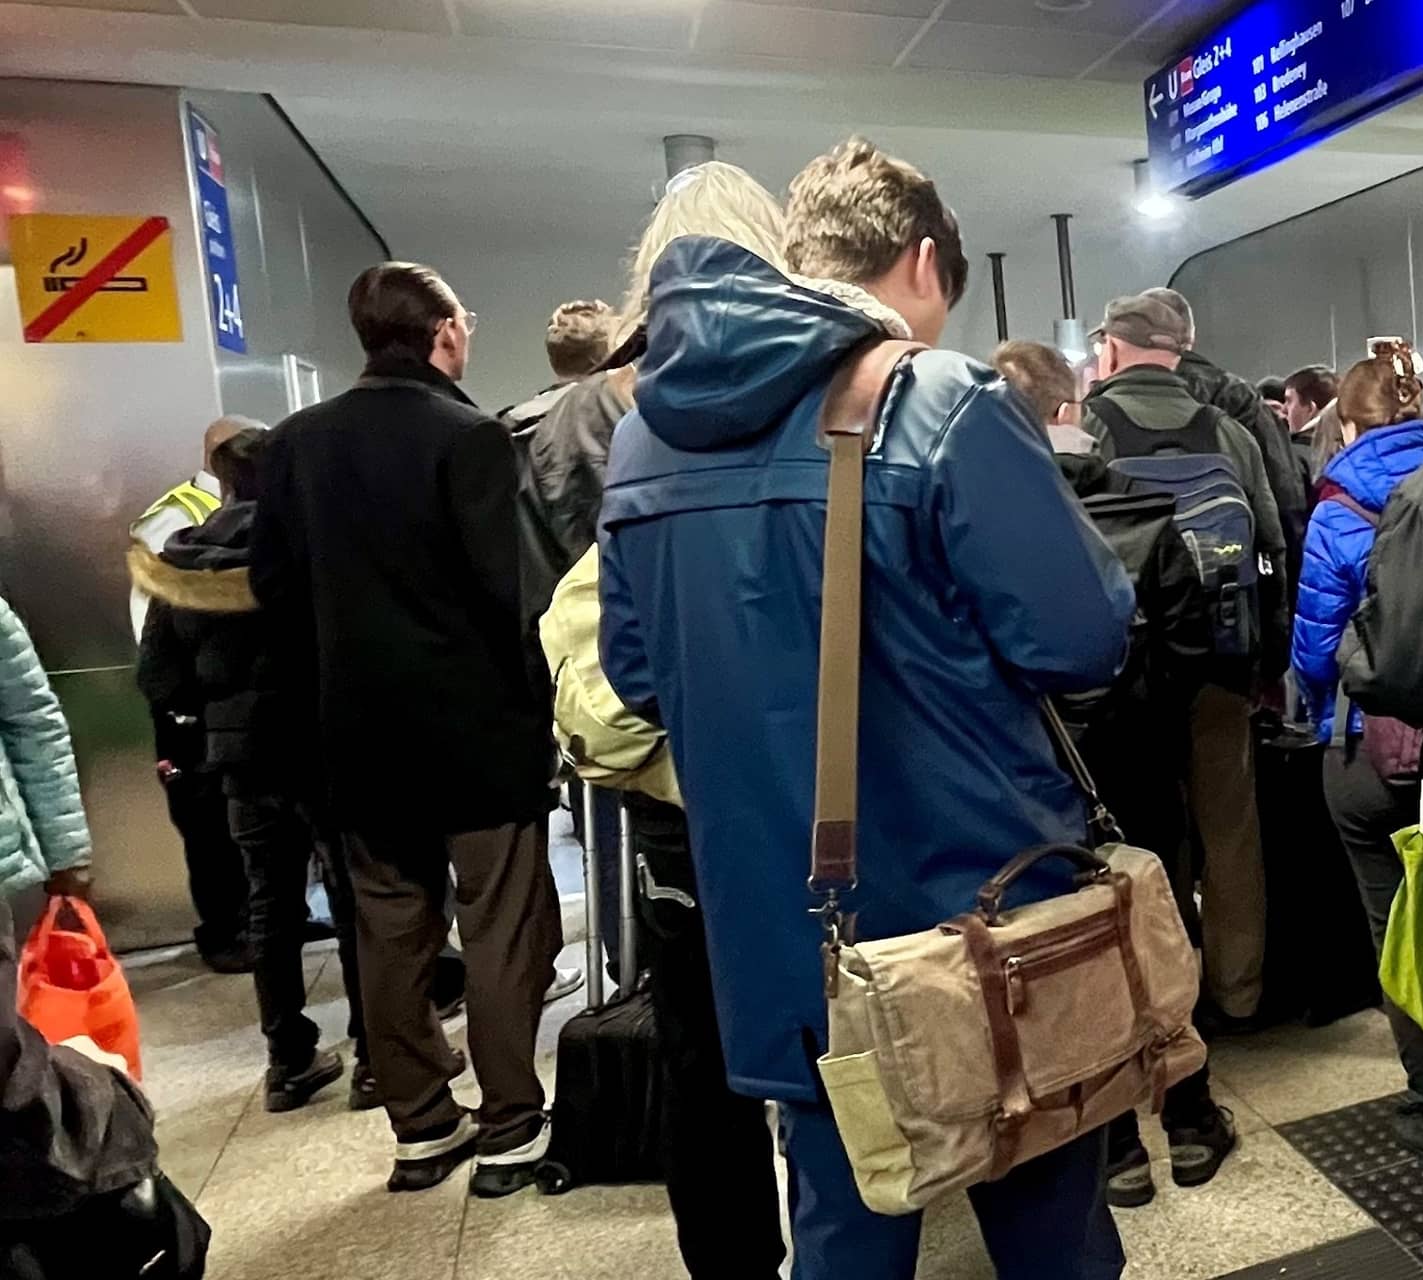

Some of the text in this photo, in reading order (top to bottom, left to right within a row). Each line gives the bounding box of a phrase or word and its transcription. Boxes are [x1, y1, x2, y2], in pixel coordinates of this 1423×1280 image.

[1168, 70, 1178, 99] U
[1193, 52, 1213, 79] Gleis
[1213, 37, 1232, 67] 2+4
[213, 273, 243, 338] 2+4
